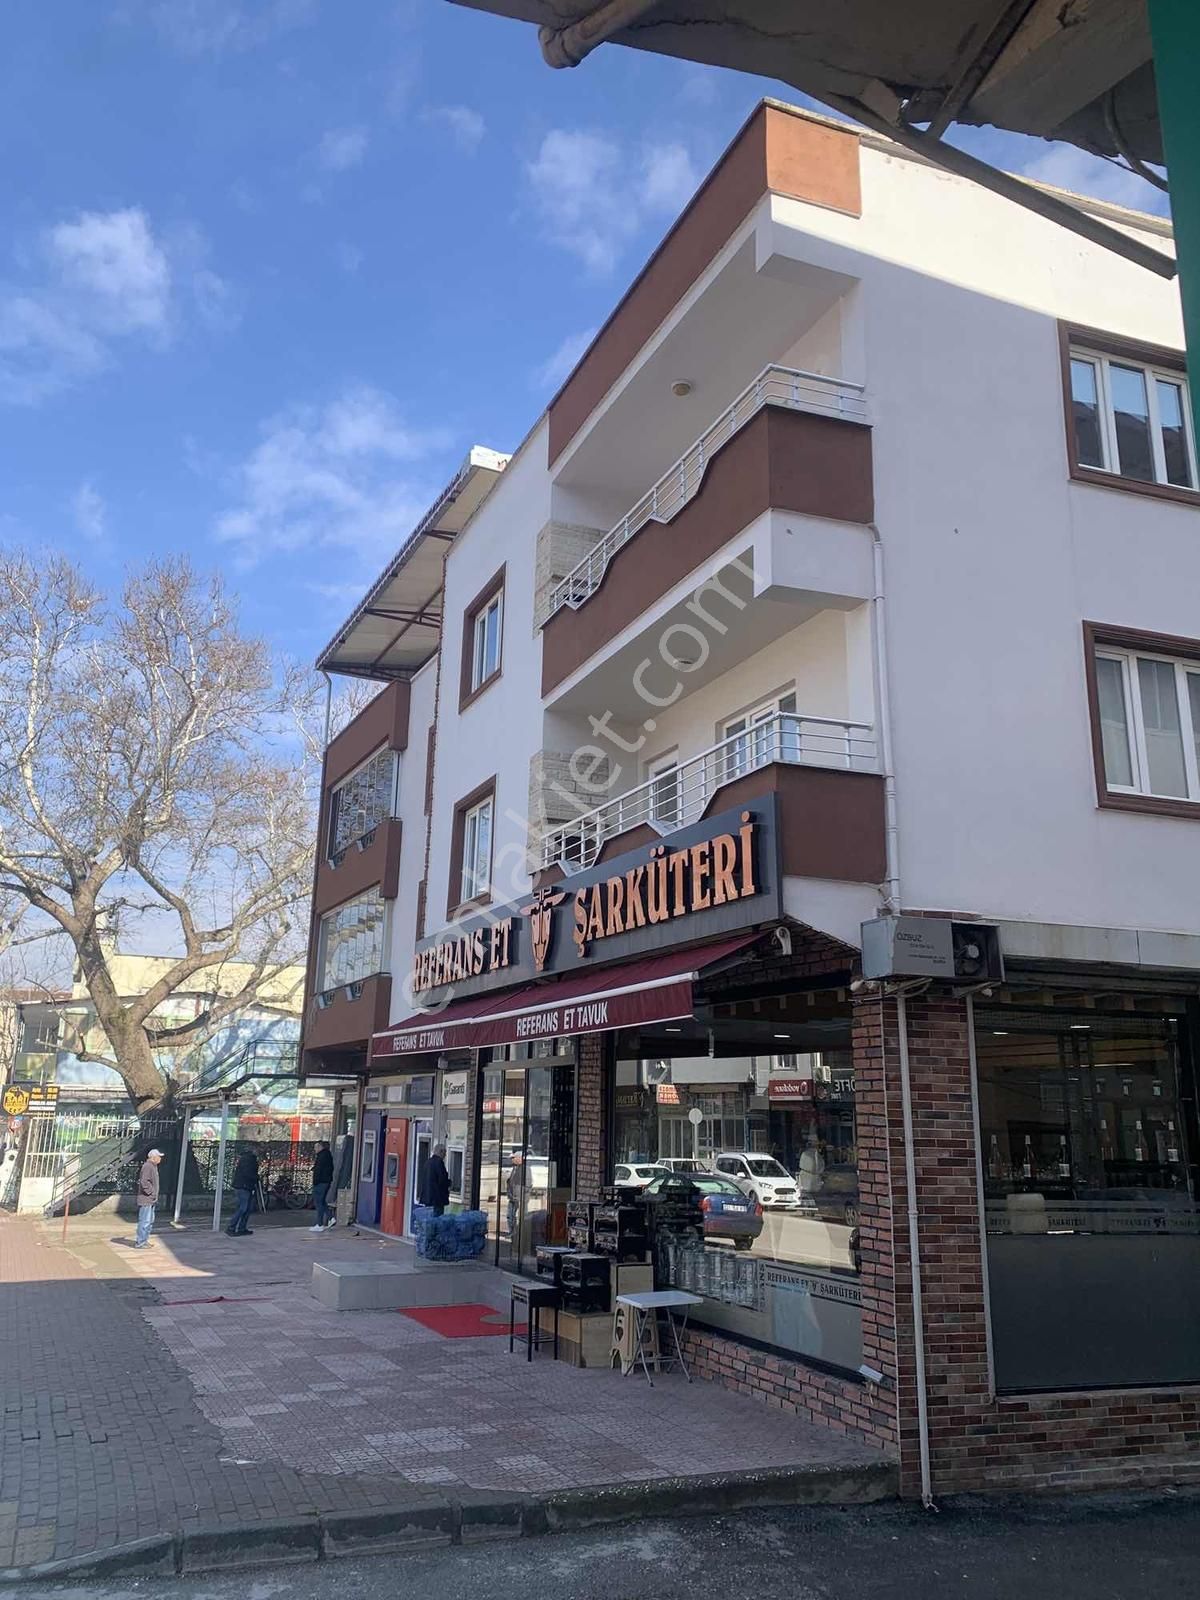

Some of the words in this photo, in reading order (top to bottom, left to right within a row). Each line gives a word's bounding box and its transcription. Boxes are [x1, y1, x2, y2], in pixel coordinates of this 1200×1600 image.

[573, 811, 756, 958] ŞARKÜTERİ
[412, 928, 484, 992] REFERANS
[490, 917, 512, 970] ET
[517, 1014, 558, 1037] REFERANS
[564, 1008, 576, 1030] ET
[577, 1001, 609, 1028] TAVUK
[393, 1033, 417, 1051] REFERANS
[820, 1284, 862, 1302] ŞARKÜTERİ
